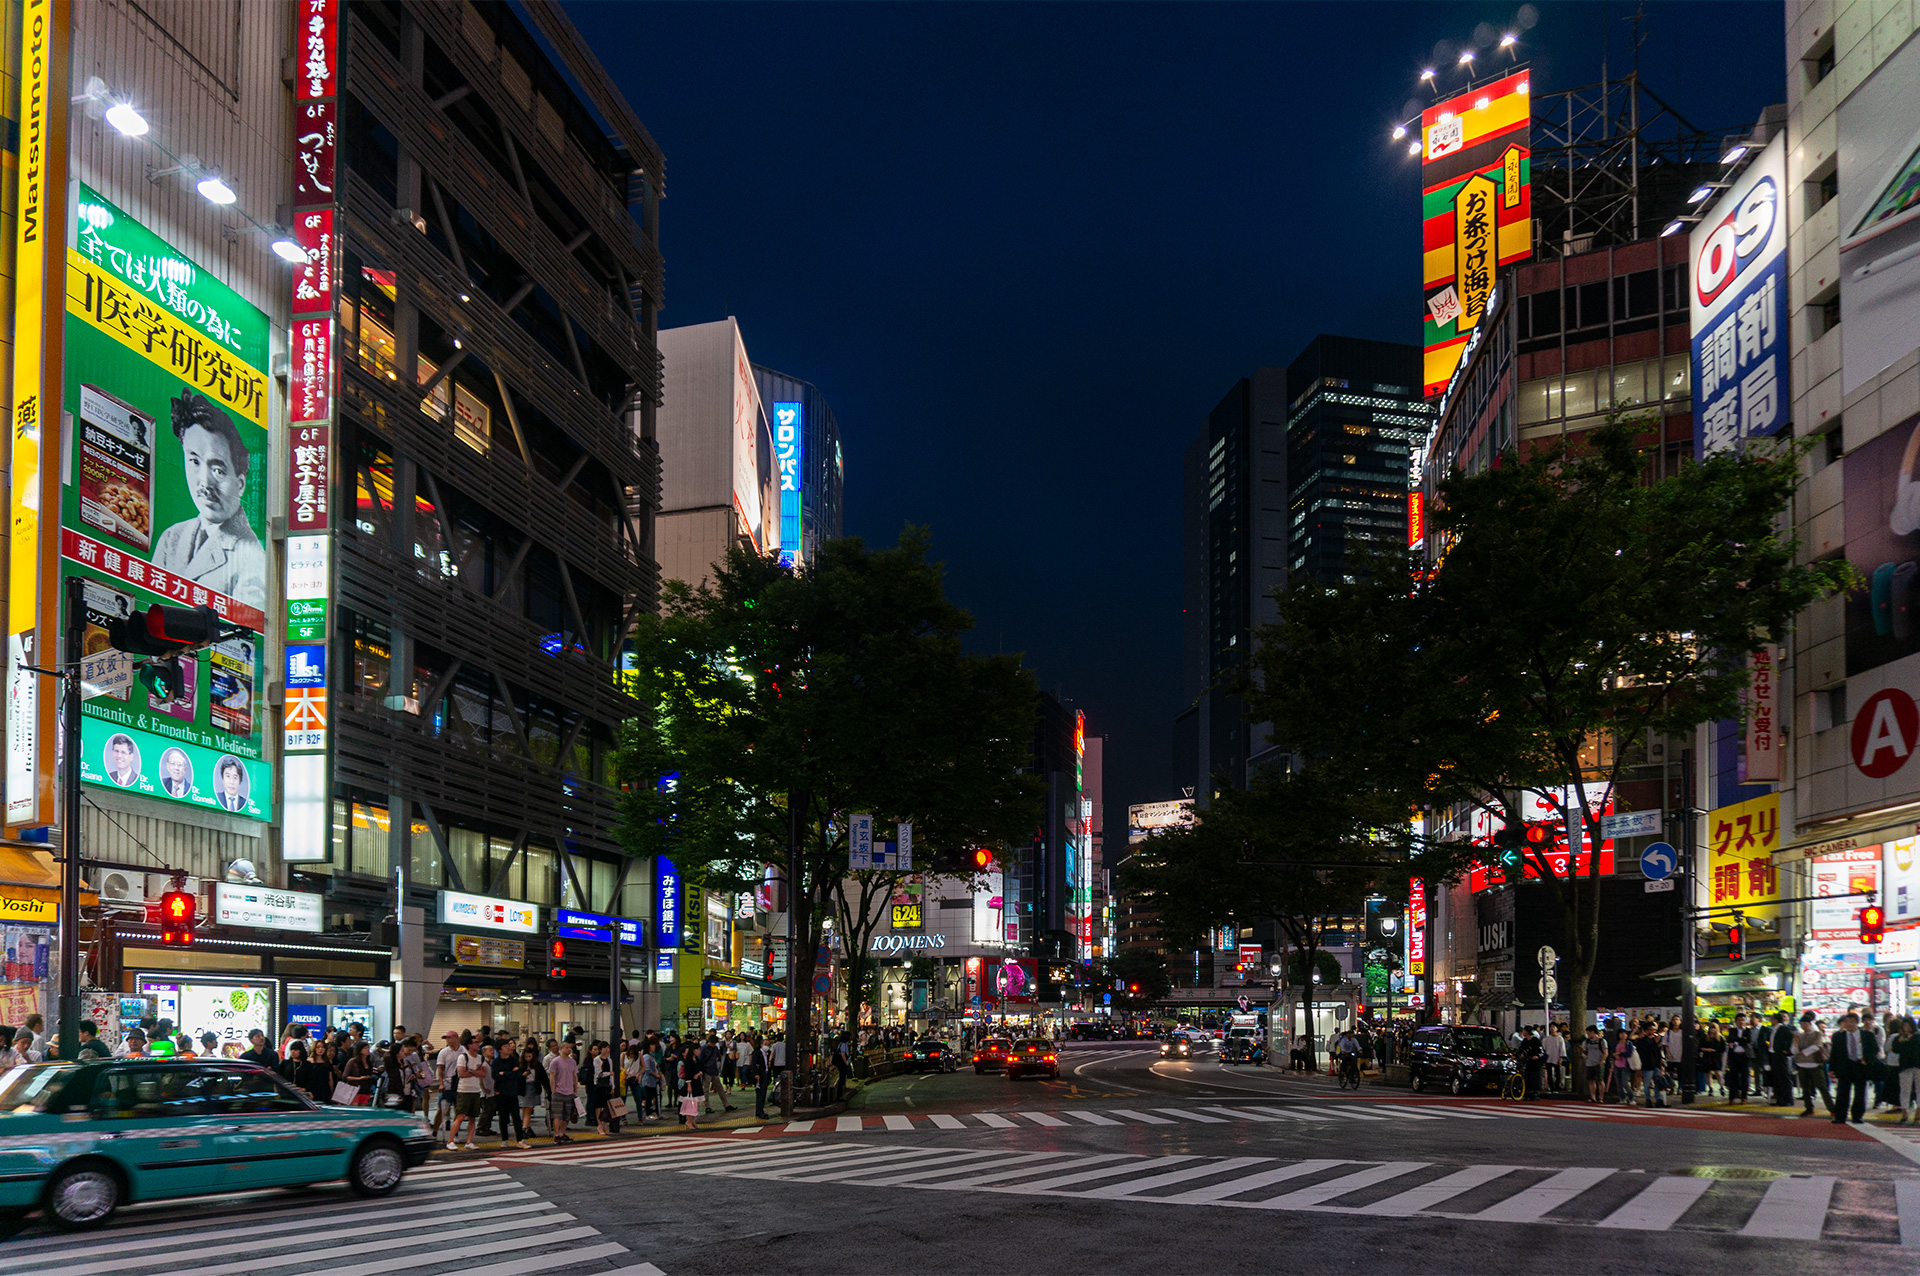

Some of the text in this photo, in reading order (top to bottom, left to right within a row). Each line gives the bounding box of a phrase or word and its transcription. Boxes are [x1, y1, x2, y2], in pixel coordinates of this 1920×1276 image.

[305, 15, 330, 97] 牛たん焼き
[24, 15, 43, 244] Matsumoto
[306, 104, 325, 118] 6F
[305, 215, 322, 229] 6F
[1699, 181, 1774, 295] OS
[79, 224, 242, 350] 全ては人類の為に
[302, 323, 320, 337] 6F
[1701, 273, 1777, 402] 調剤
[1702, 353, 1778, 459] 薬局
[85, 426, 146, 468] 納豆キナーゼ
[300, 428, 319, 441] 6F
[777, 408, 797, 491] サロンパス
[293, 444, 320, 522] 餃子屋台
[78, 538, 228, 617] 新健康活力製品
[299, 627, 314, 638] 5F
[85, 650, 129, 681] 道玄坂下
[114, 672, 128, 684] shita
[1753, 650, 1772, 751] 処方せん受付
[137, 713, 148, 729] &
[151, 716, 198, 745] Empathy
[201, 731, 212, 746] in
[215, 734, 258, 760] Medicine
[288, 734, 321, 745] B1F B2F
[1860, 698, 1909, 767] A
[81, 770, 103, 782] Asano
[859, 819, 869, 865] 道玄坂下
[1606, 813, 1656, 829] 道玄坂下
[1606, 828, 1640, 837] Dogenzaka
[1714, 807, 1776, 857] クスリ
[1803, 838, 1858, 858] BIC CAMERA
[1845, 849, 1875, 861] Free
[1714, 854, 1777, 904] 調剤
[264, 893, 296, 909] 渋谷駅
[662, 875, 675, 934] みずほ銀行
[1832, 930, 1861, 938] CAME
[291, 1013, 321, 1023] MIZUHO
